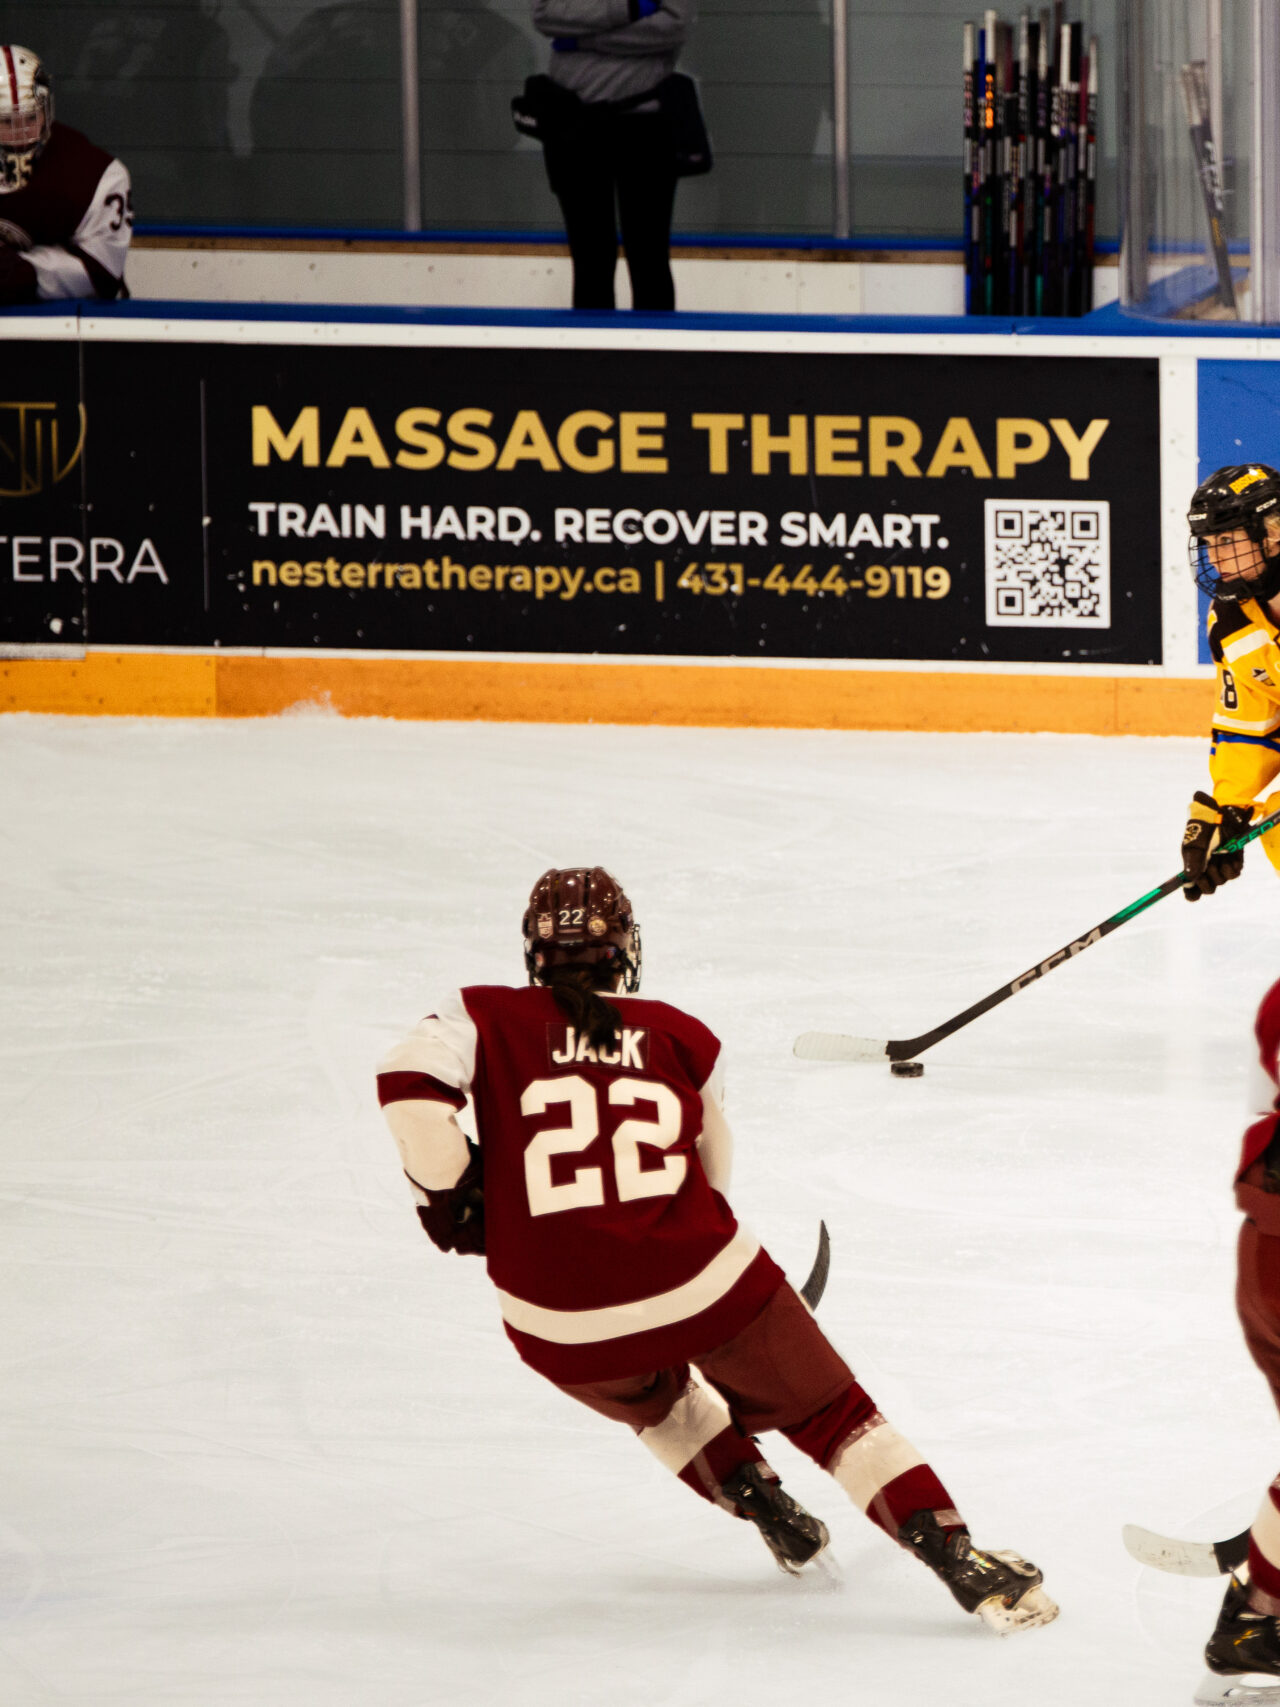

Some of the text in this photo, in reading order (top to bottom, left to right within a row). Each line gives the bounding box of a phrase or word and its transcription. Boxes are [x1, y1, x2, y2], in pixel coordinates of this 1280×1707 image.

[251, 405, 1110, 481] MASSAGE THERAPY
[248, 502, 950, 549] TRAIN HARD. RECOVER SMART.
[252, 556, 641, 600] nesterratherapy.ca
[677, 562, 952, 599] 431-444-9119
[1220, 668, 1240, 712] 8
[558, 908, 585, 926] 22
[519, 1075, 688, 1217] 22
